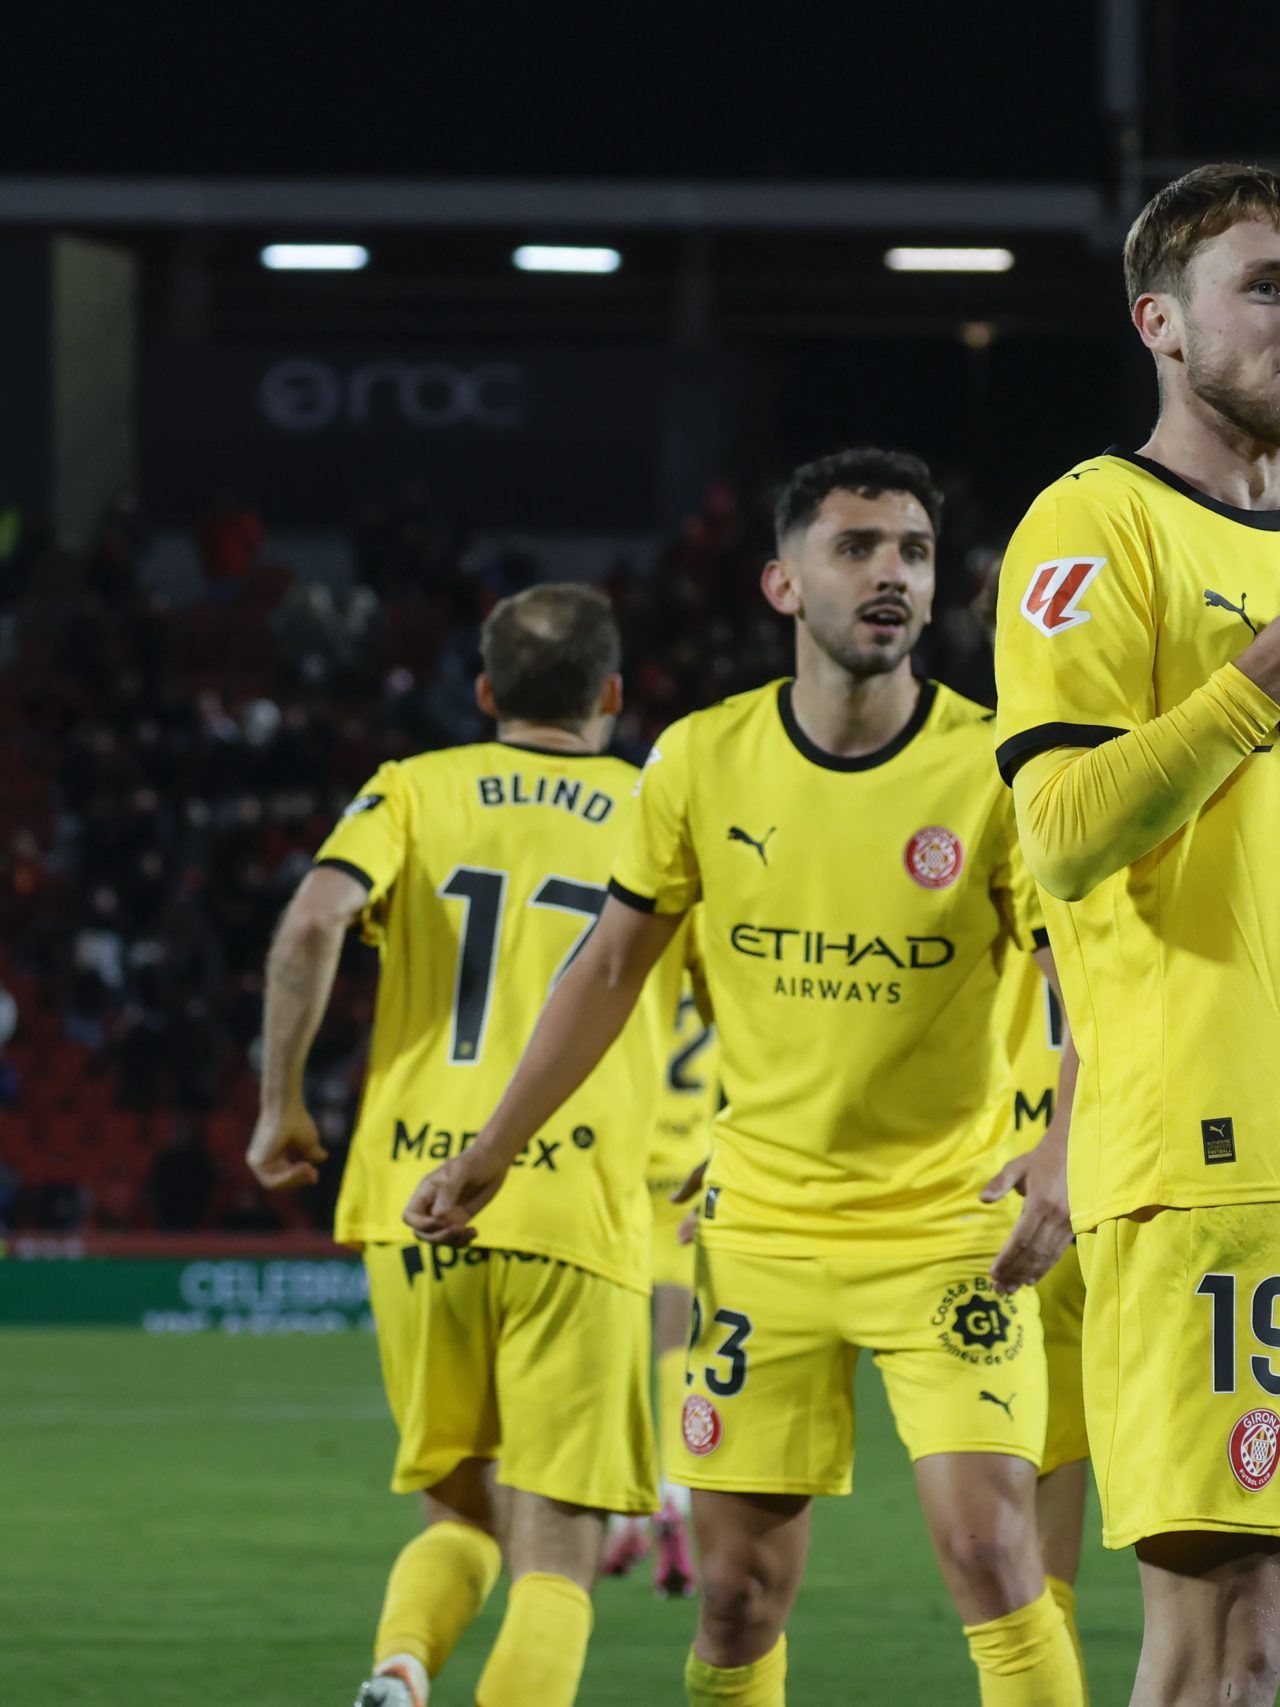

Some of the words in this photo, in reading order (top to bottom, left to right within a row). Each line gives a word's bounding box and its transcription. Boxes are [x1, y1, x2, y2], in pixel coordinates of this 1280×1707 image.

[478, 772, 615, 825] BLIND
[730, 923, 956, 970] ETIHAD
[774, 976, 902, 1005] AIRWAYS
[931, 1283, 968, 1326] Costa
[1243, 1412, 1280, 1434] GIRONA
[1239, 1468, 1258, 1486] FUTBOL
